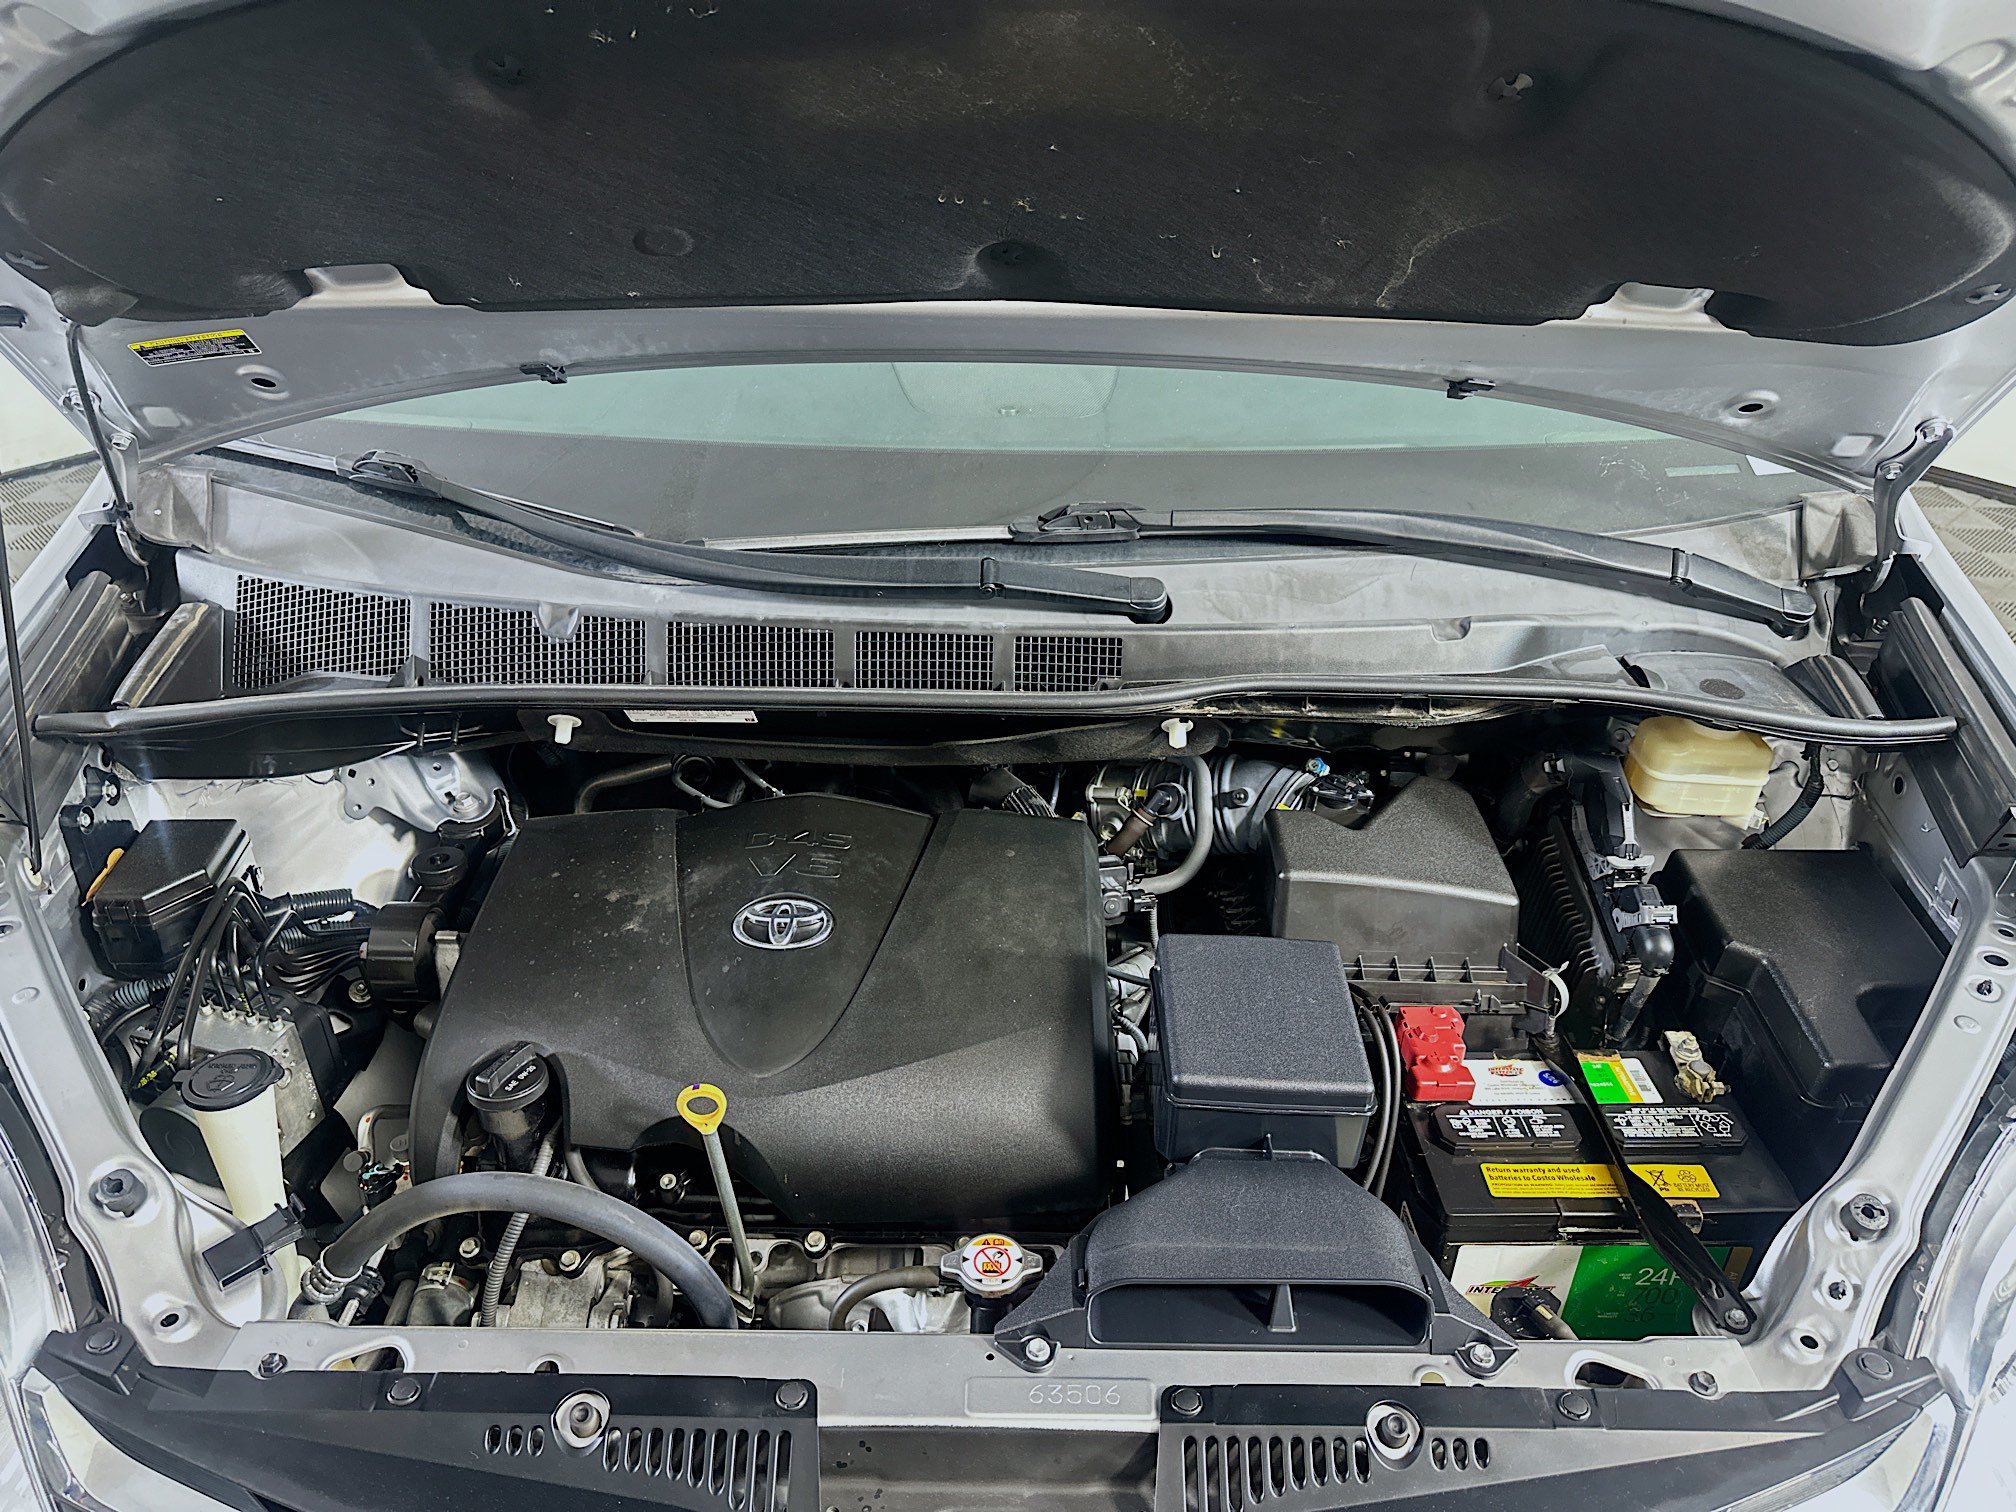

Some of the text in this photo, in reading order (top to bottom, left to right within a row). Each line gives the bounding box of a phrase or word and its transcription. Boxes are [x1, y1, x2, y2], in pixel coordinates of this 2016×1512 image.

[504, 1065, 537, 1092] SAE 0W-20
[1513, 1167, 1546, 1175] warranty
[1029, 1384, 1121, 1405] 63506
